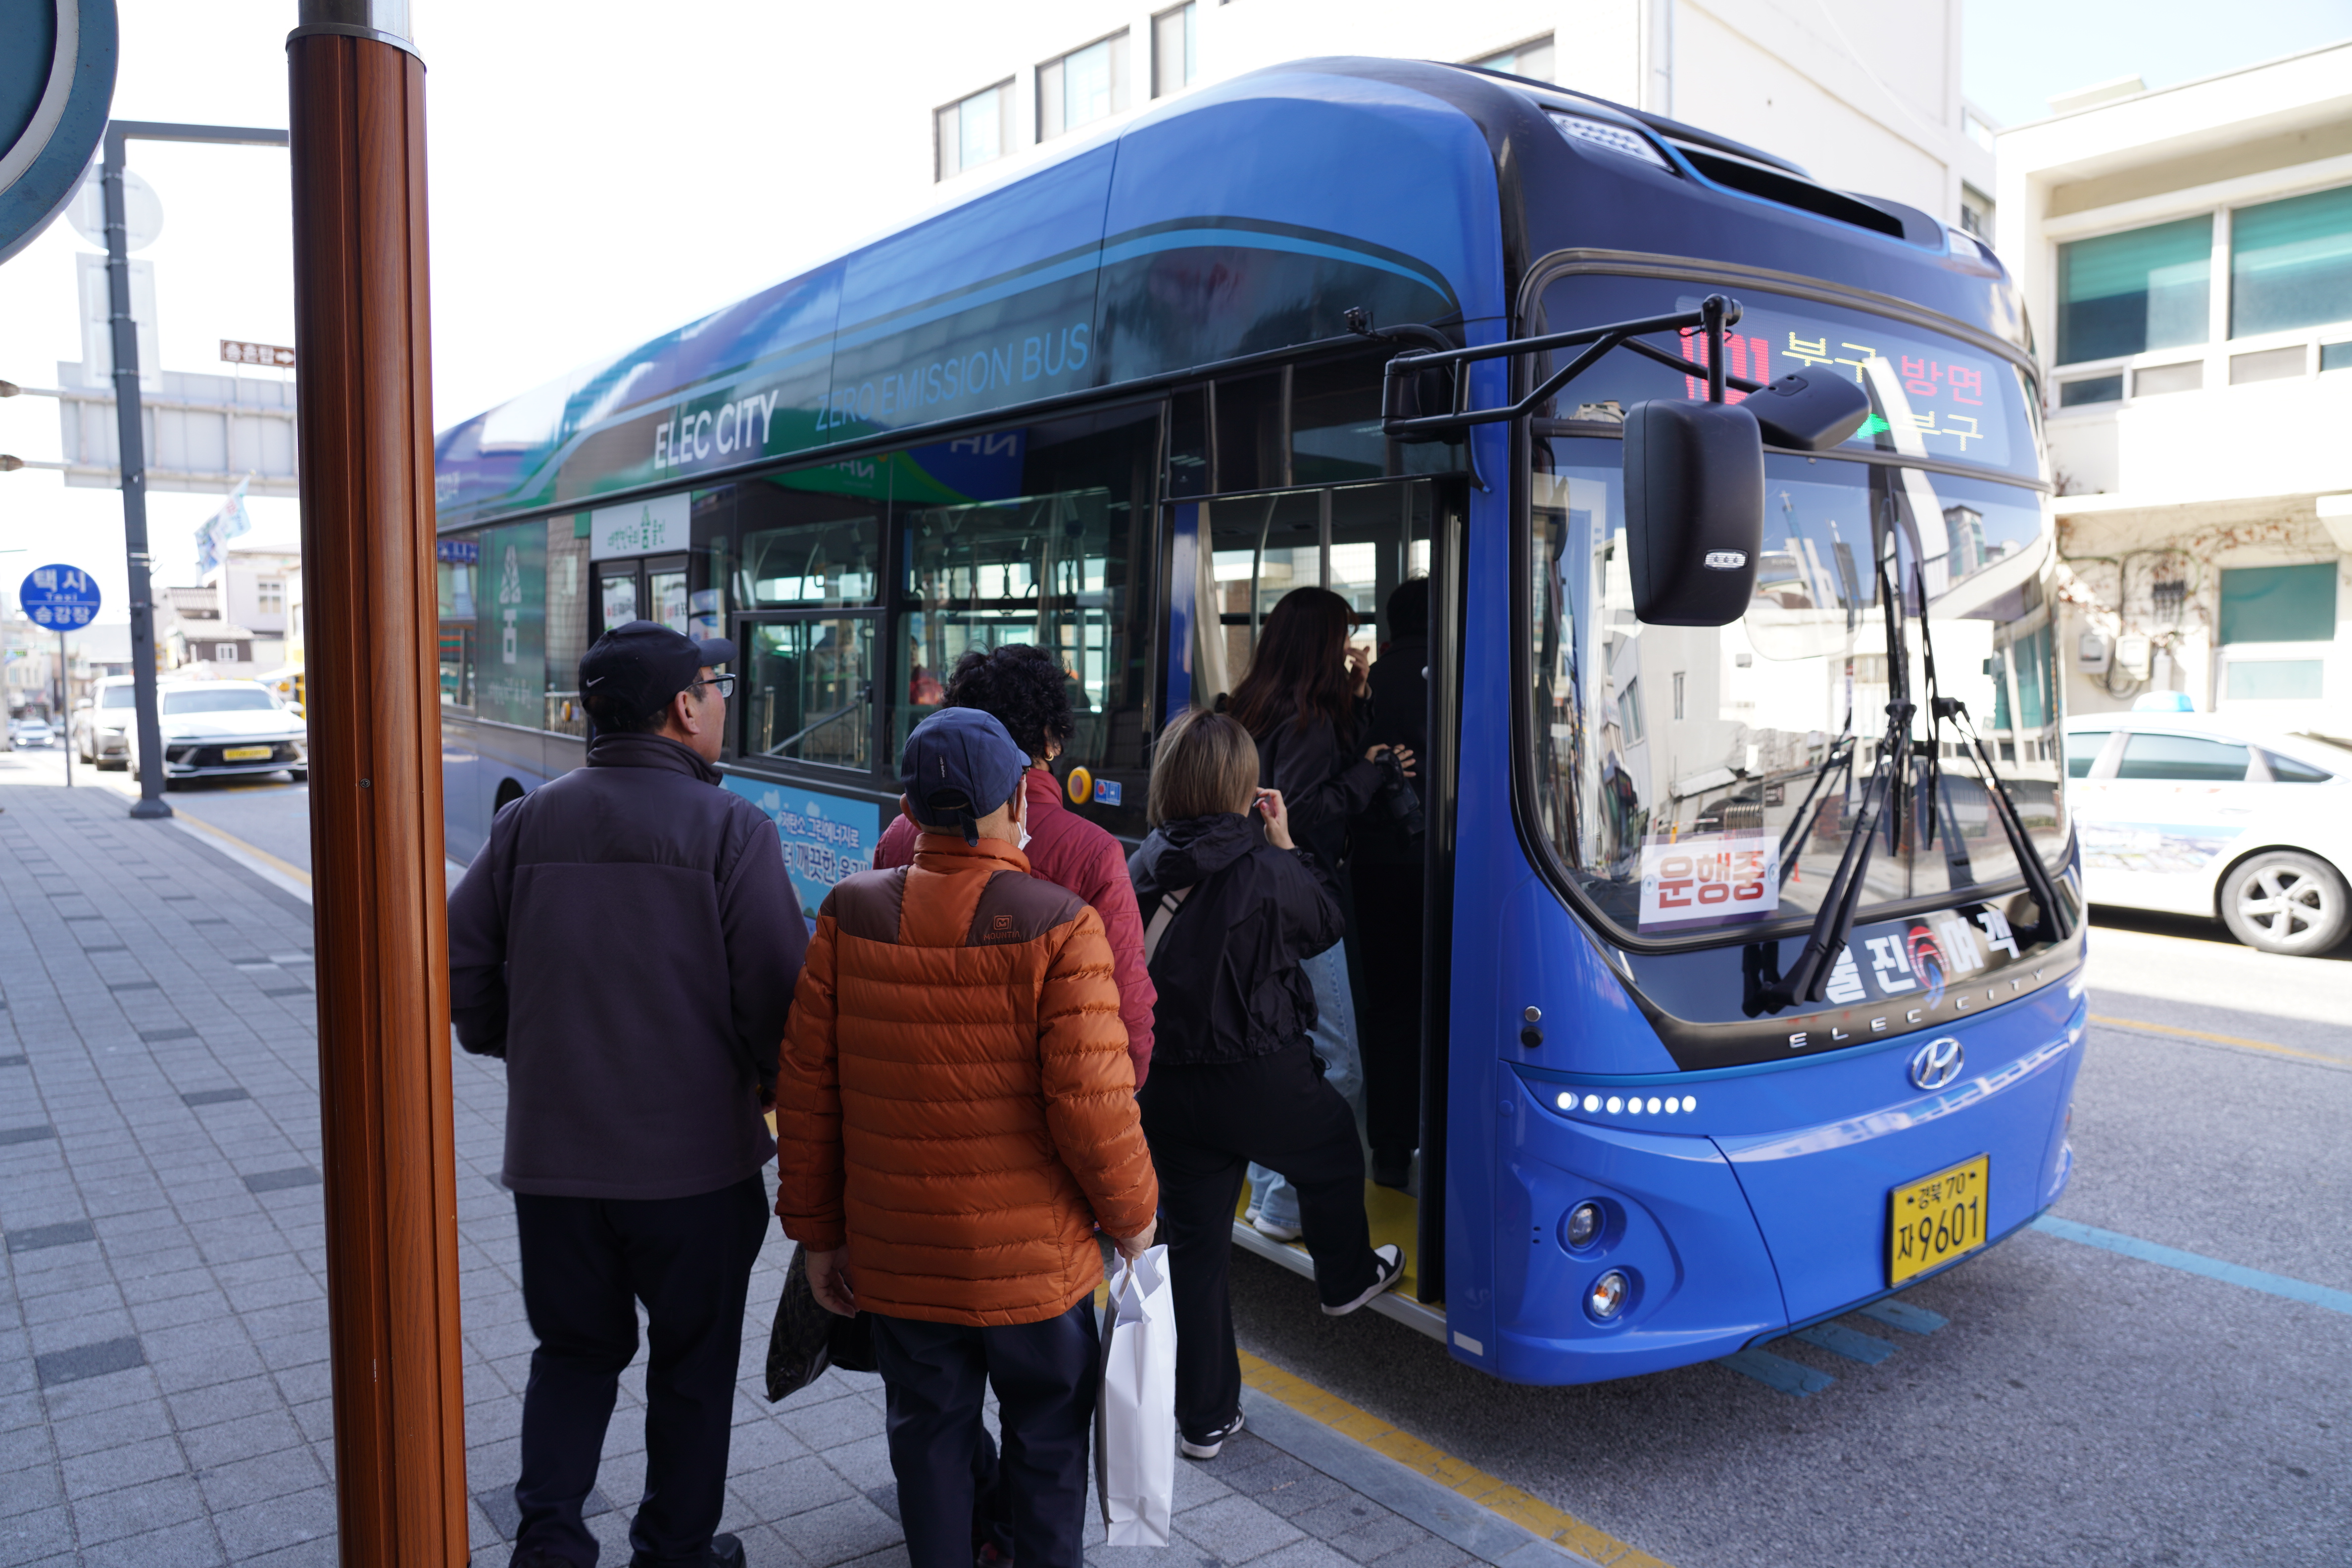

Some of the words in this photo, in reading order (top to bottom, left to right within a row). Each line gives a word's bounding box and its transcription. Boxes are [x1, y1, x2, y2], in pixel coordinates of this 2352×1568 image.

[815, 382, 875, 432] ZERO
[881, 343, 1013, 415] EMISSION
[1021, 322, 1089, 383] BUS
[1782, 331, 1879, 383] 부구
[1902, 355, 1983, 406] 방면
[654, 409, 712, 470] ELEC
[716, 389, 779, 455] CITY
[1897, 406, 1983, 451] 부구
[33, 569, 87, 593] 택시
[34, 605, 91, 625] 승강장
[781, 810, 806, 835] 저탄소
[807, 817, 860, 849] 그린에너지로
[783, 840, 795, 875] 더
[795, 841, 837, 887] 깨끗한
[1658, 850, 1765, 909] 운행중
[983, 931, 1020, 941] MOUNTIA
[1825, 934, 1917, 1004] 울진
[1939, 909, 2021, 974] 여객
[1789, 1008, 1922, 1049] ELEC
[1956, 968, 2044, 1010] CITY
